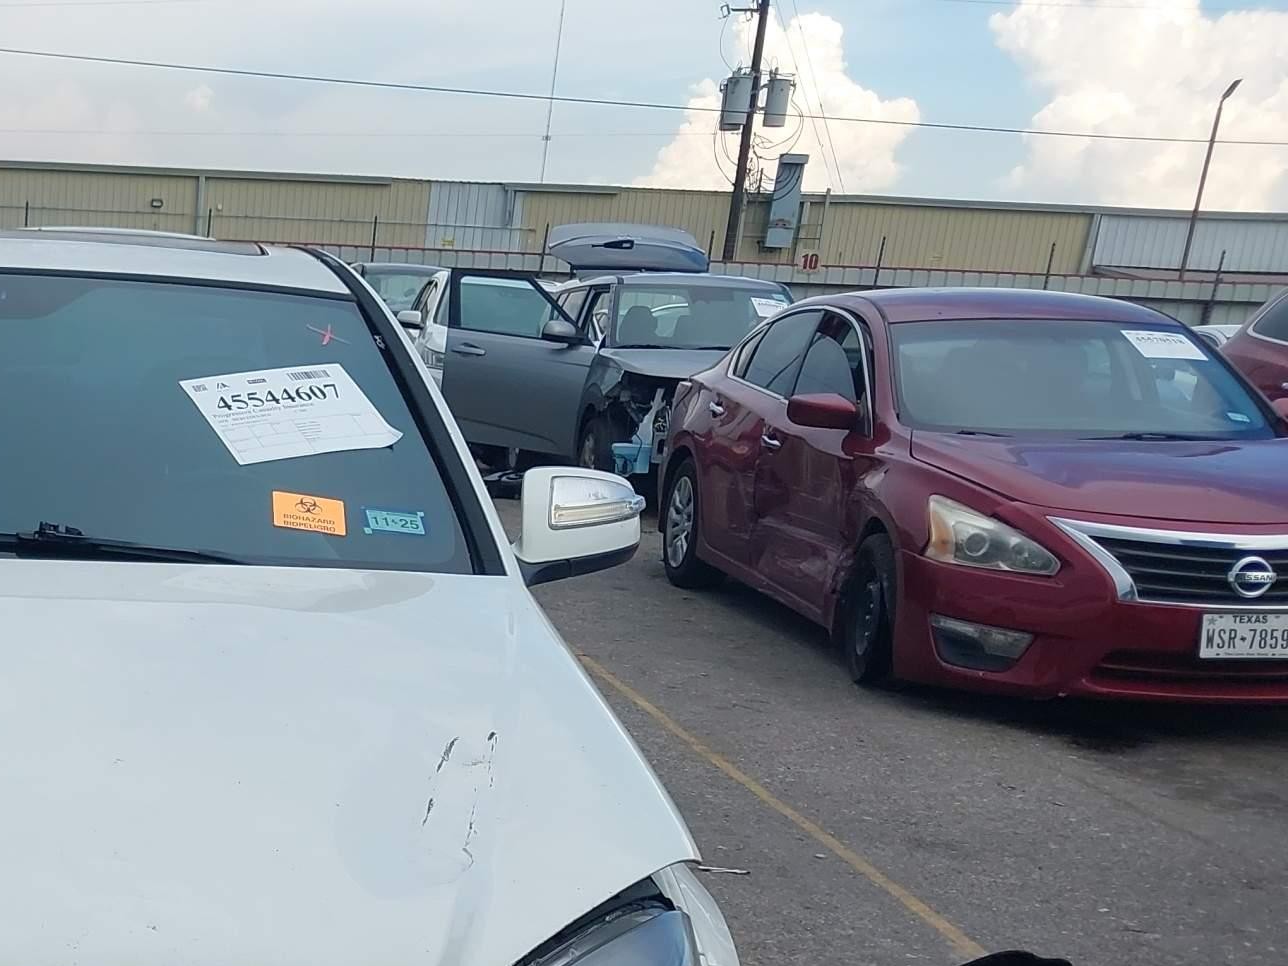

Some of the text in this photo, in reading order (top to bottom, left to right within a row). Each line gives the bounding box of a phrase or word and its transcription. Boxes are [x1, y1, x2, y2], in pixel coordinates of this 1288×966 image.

[802, 253, 819, 270] 10
[216, 383, 340, 412] 45544607
[283, 513, 335, 525] BIOHAZARD
[1232, 615, 1268, 624] TEXAS
